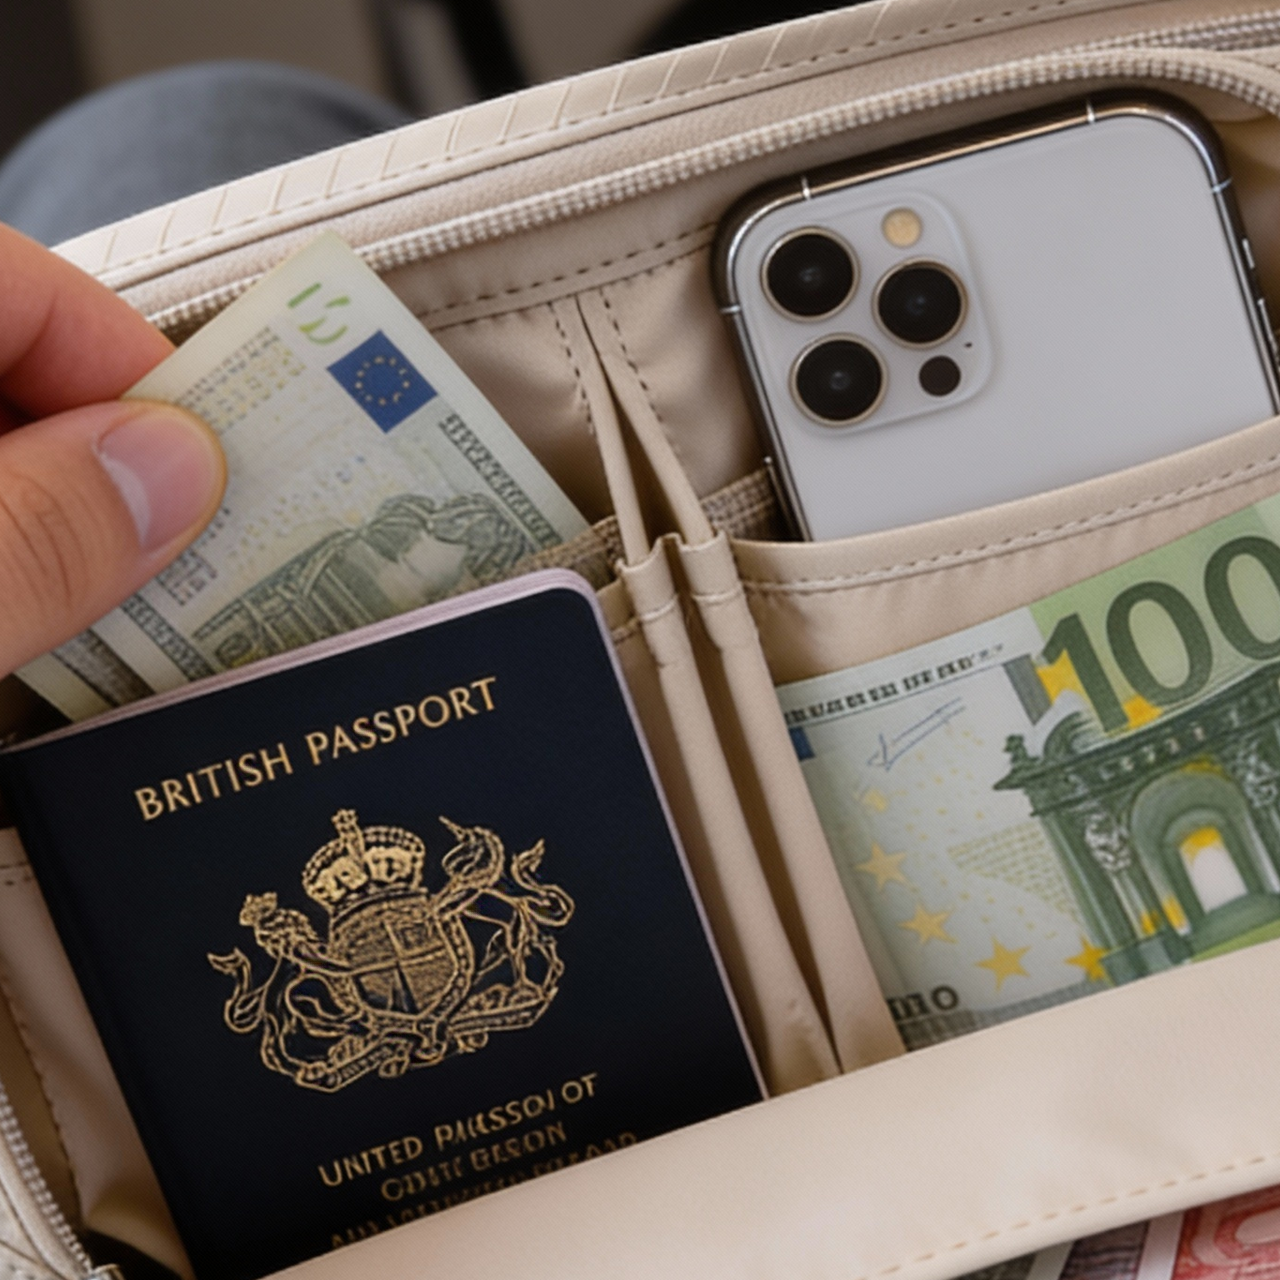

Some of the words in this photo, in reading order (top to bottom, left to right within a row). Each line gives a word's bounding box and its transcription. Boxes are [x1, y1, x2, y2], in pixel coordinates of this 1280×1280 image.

[135, 742, 293, 820] BRITISH
[304, 676, 496, 765] PASSPORT
[318, 1136, 423, 1188] UNITED
